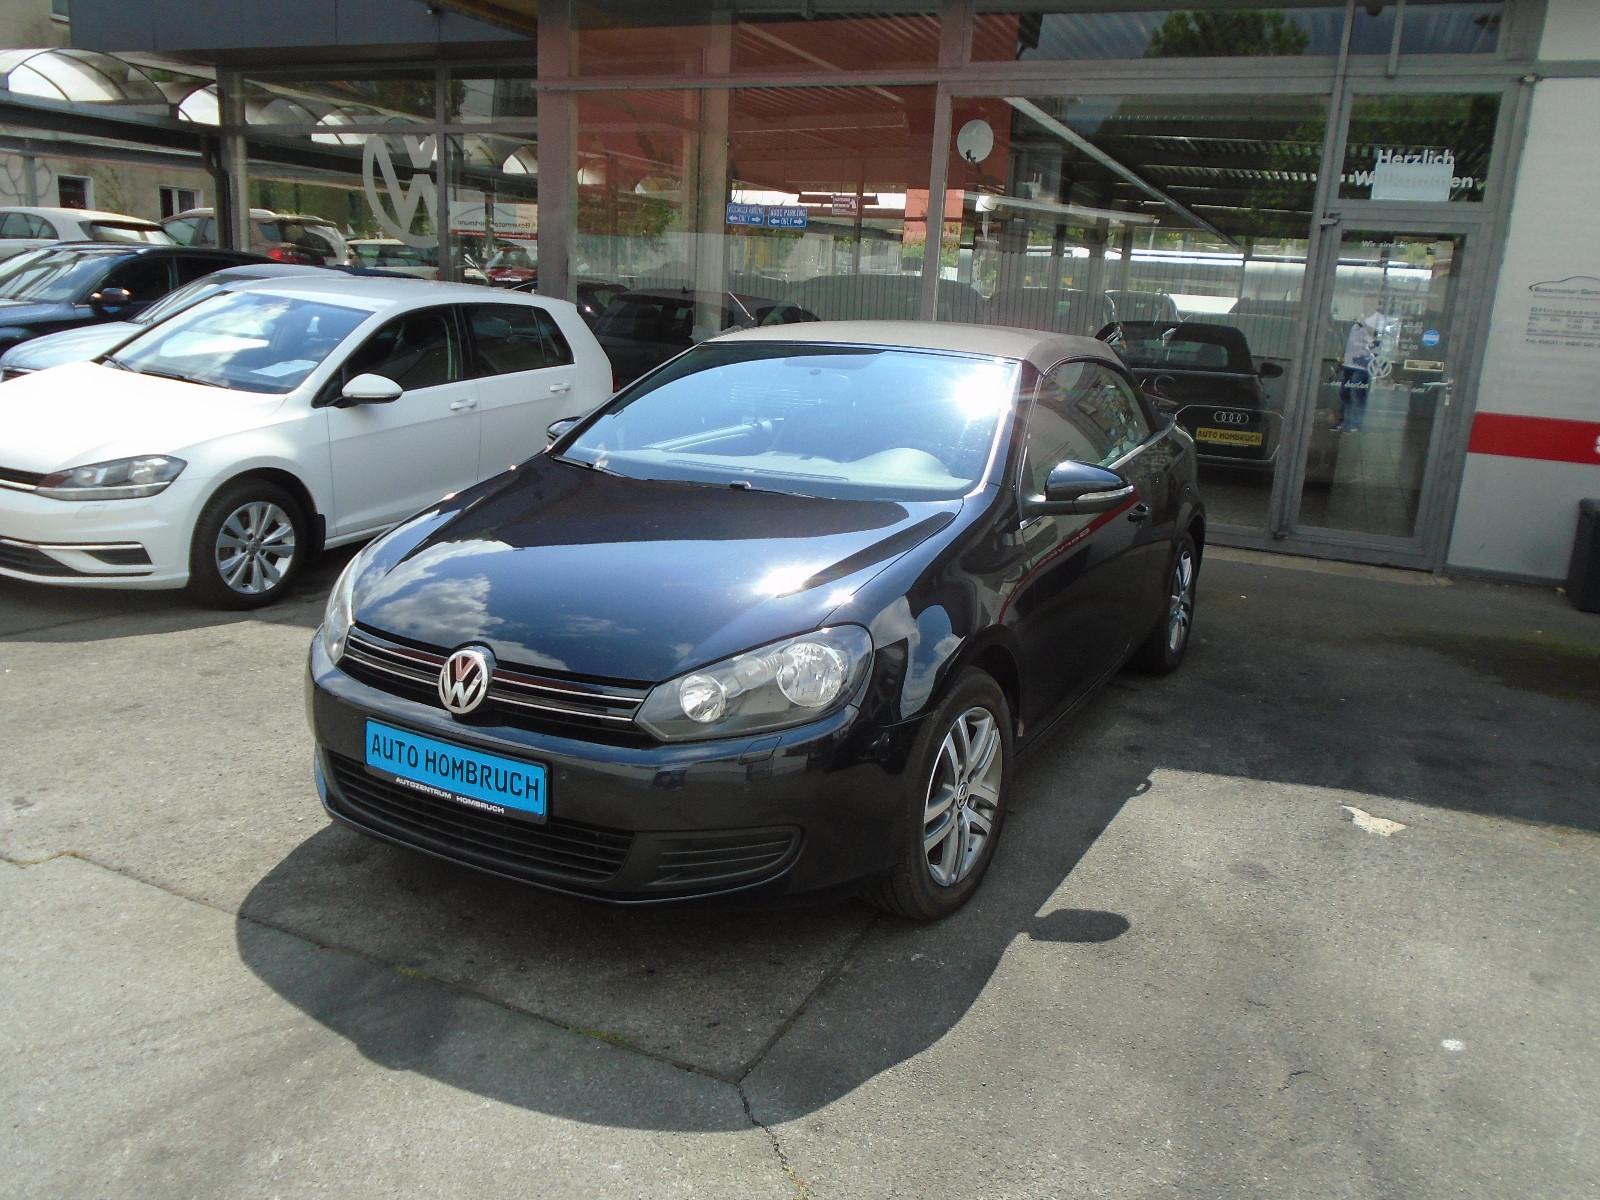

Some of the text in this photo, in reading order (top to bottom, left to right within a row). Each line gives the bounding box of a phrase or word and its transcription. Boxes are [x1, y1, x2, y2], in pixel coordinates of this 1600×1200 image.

[1378, 149, 1455, 166] Herzlich
[1198, 429, 1218, 439] AUTO
[371, 733, 540, 802] AUTO HOMBRUCH
[395, 776, 505, 814] AUTOZENTRUM HOMBRUCH
